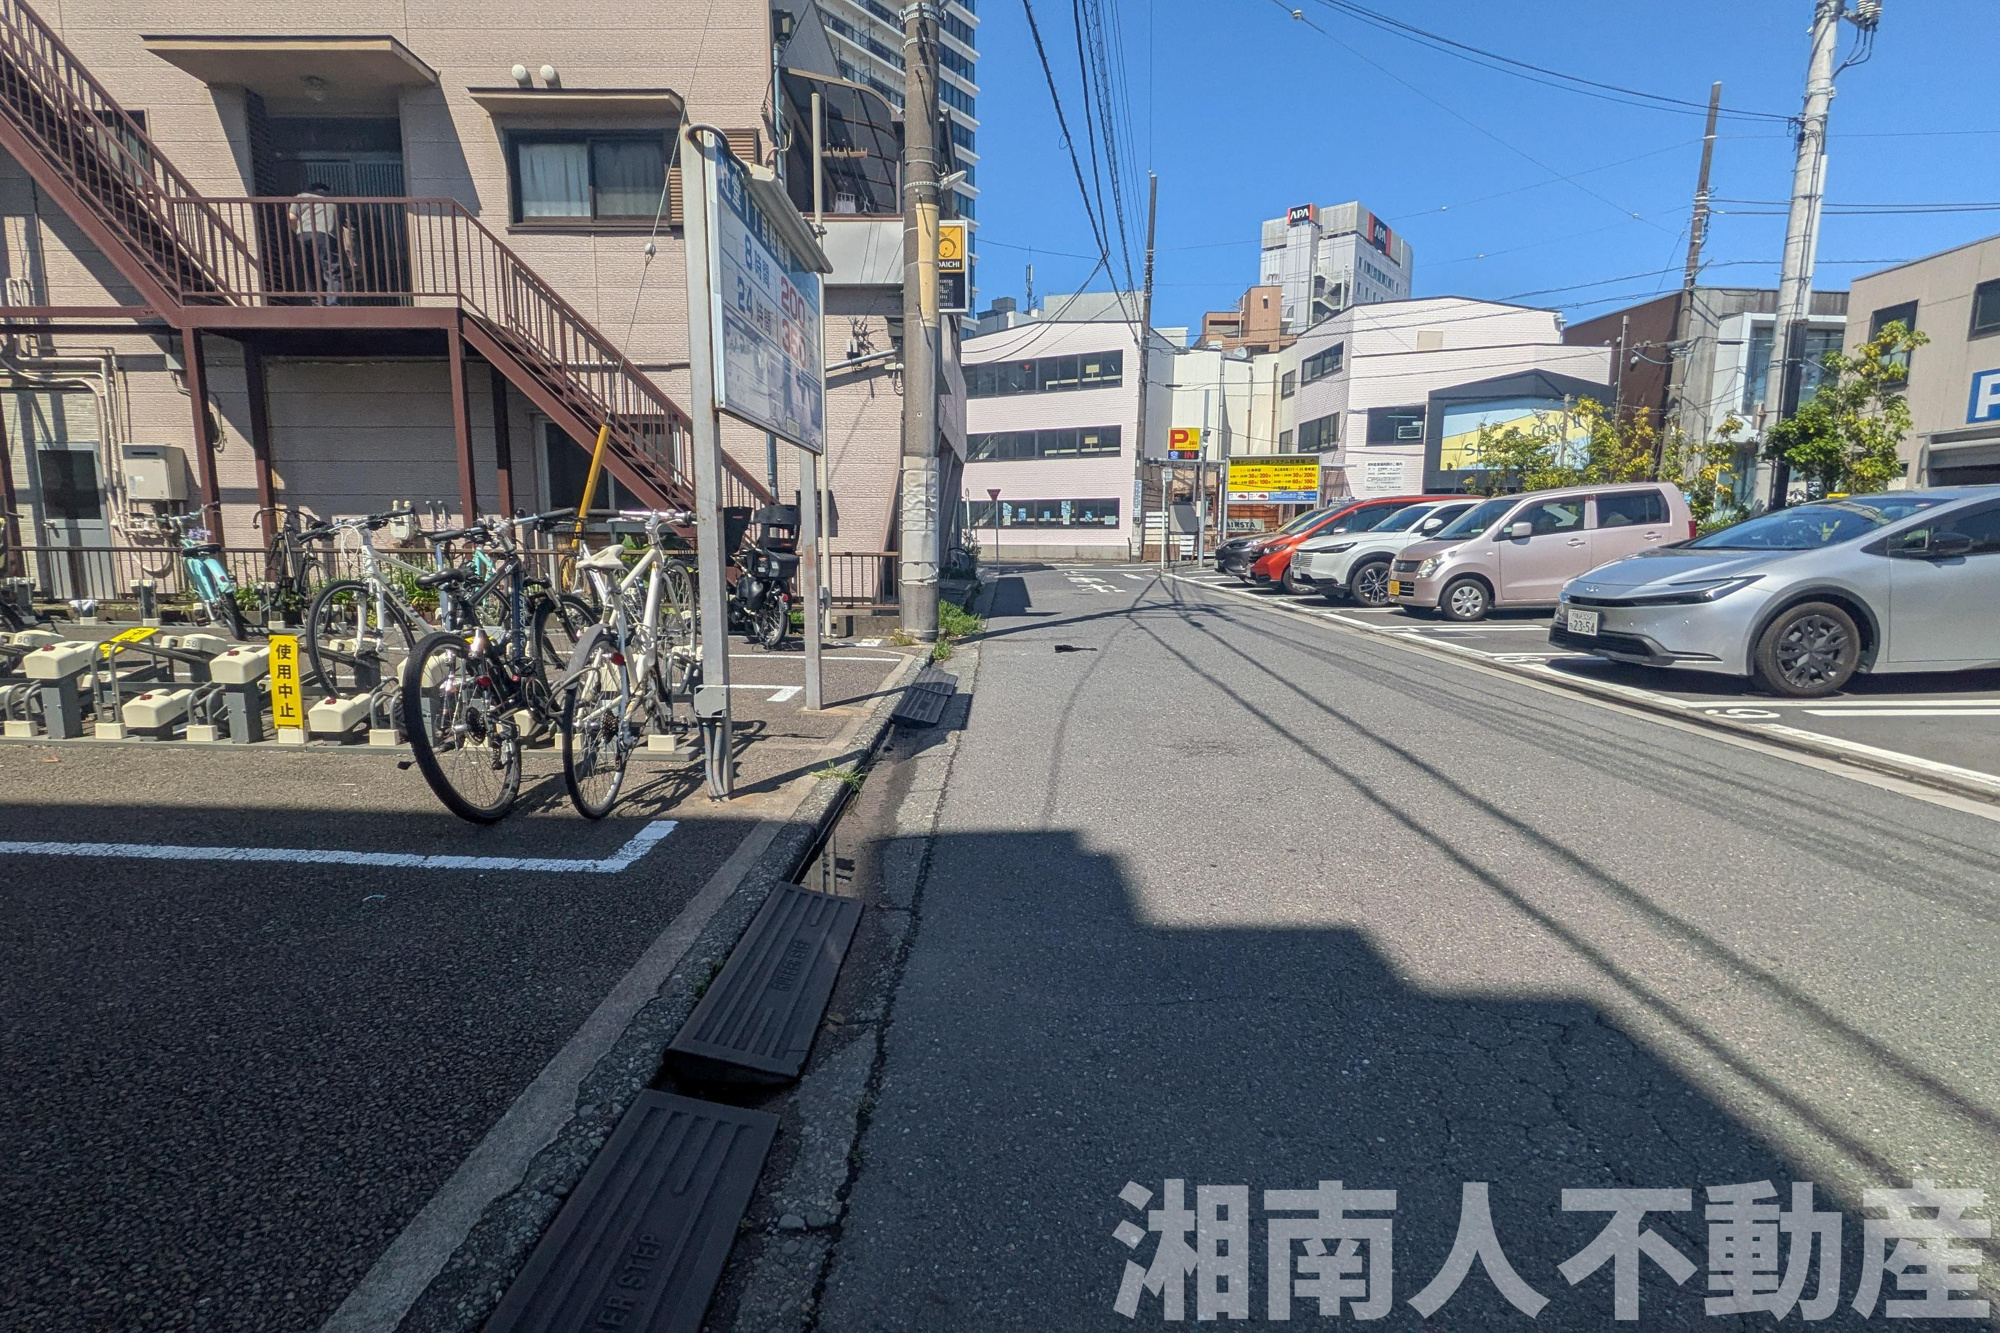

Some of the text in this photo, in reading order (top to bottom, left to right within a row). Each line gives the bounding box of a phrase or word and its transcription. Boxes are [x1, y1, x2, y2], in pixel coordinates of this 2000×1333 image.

[1290, 207, 1309, 220] APA
[1170, 429, 1189, 449] P
[1184, 451, 1196, 459] IN
[1574, 620, 1595, 633] 23-54
[276, 644, 295, 718] 使用中止
[615, 1233, 664, 1291] STEP
